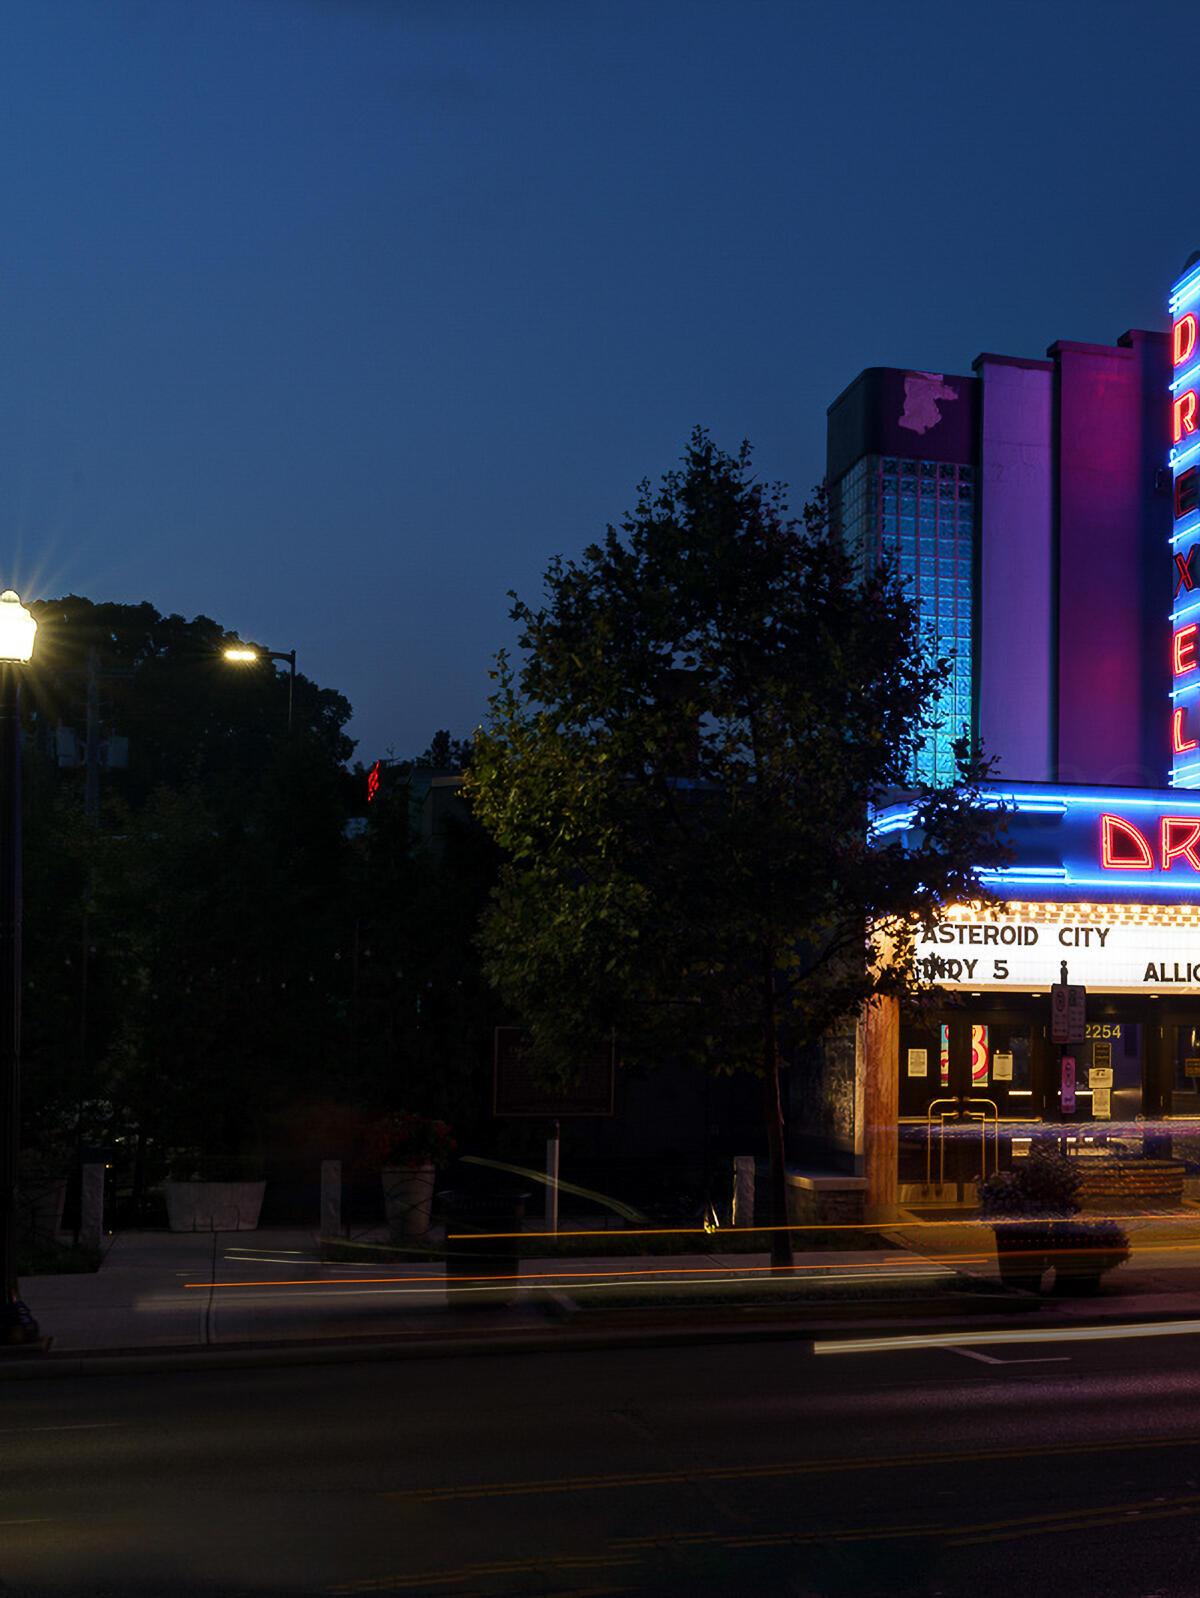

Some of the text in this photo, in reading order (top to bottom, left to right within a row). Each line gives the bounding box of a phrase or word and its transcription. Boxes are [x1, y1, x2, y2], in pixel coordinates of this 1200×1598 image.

[1171, 312, 1200, 754] DREXEL
[921, 923, 1110, 948] ASTEROID CITY
[993, 959, 1009, 980] 5
[1085, 1023, 1121, 1039] 2254
